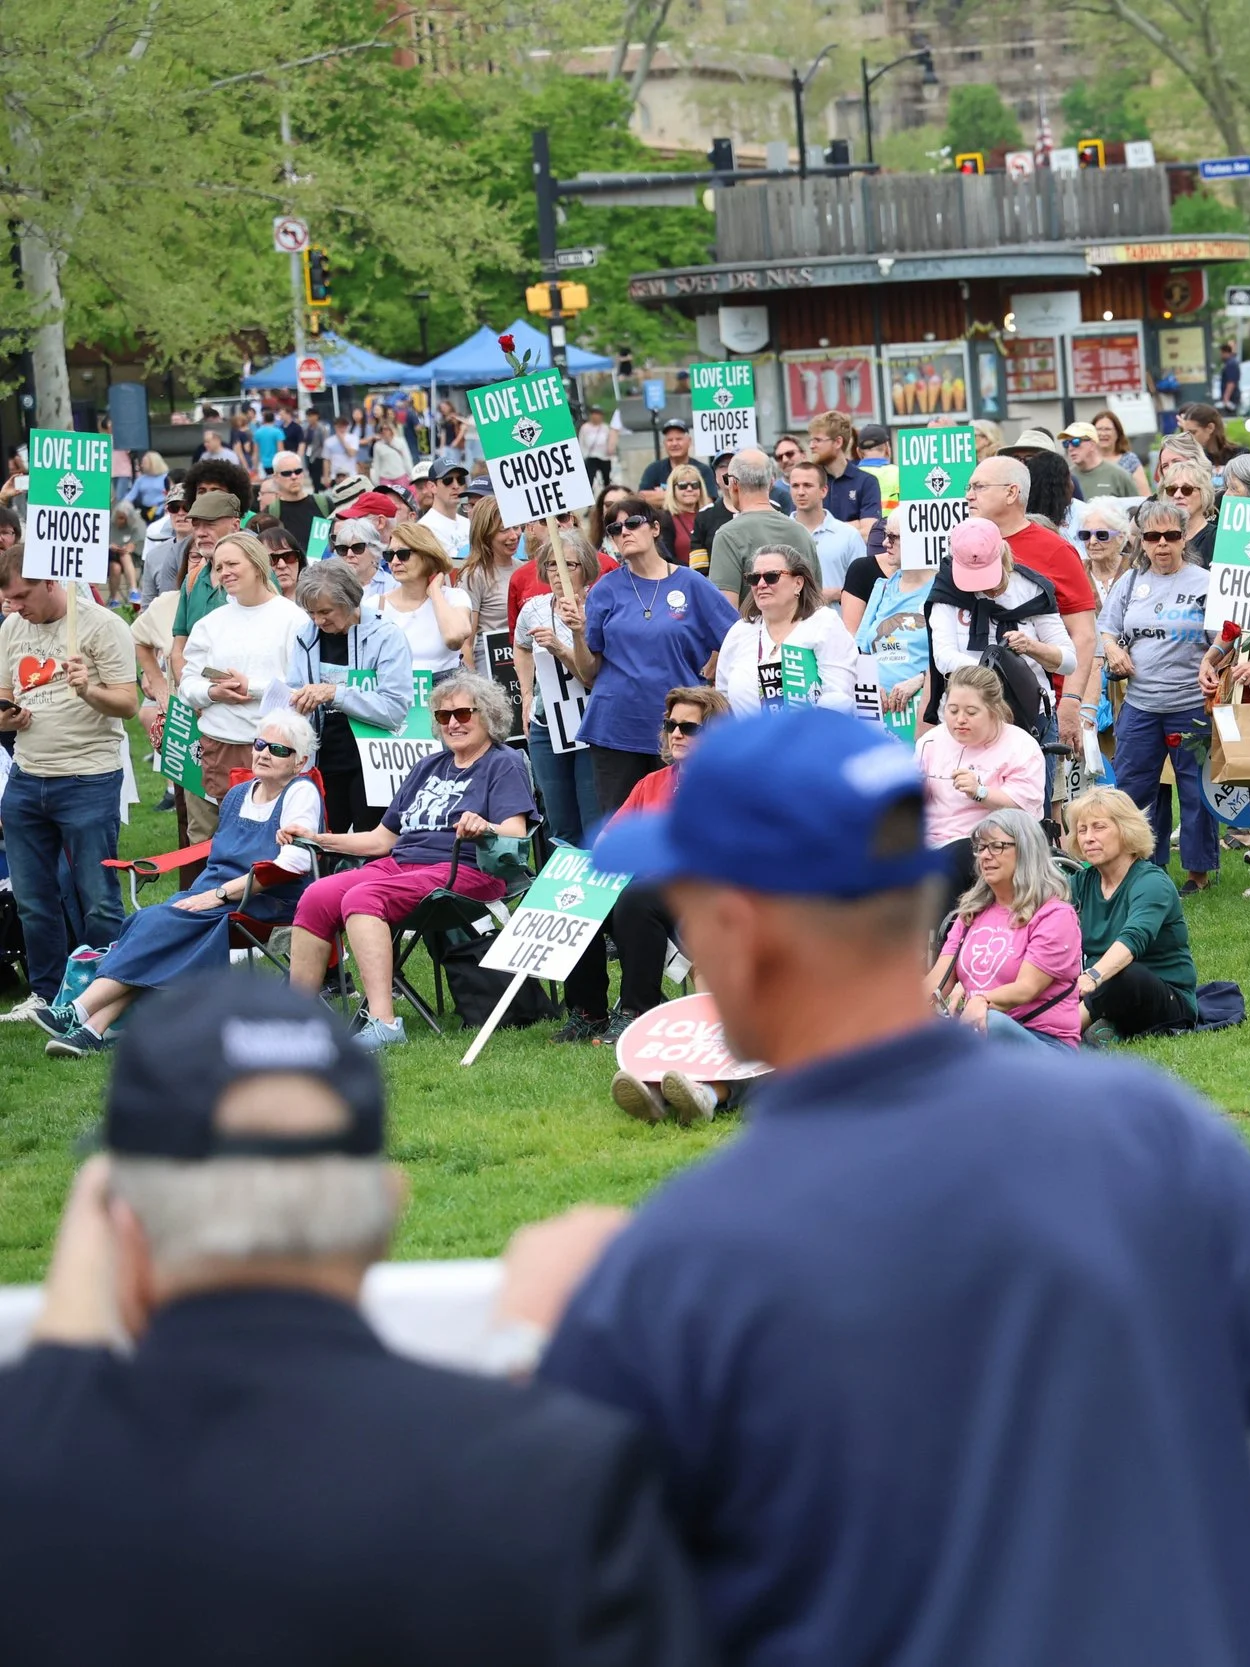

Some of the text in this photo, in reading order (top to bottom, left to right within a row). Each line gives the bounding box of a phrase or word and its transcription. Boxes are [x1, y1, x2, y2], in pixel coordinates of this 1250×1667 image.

[728, 267, 814, 289] DRNKS
[692, 365, 750, 388] LOVE LIFE
[474, 376, 563, 425] LOVE LIFE
[700, 410, 749, 431] CHOOSE
[34, 436, 108, 472] LOVE LIFE
[901, 432, 973, 466] LOVE LIFE
[500, 444, 575, 489] CHOOSE
[525, 481, 566, 517] LIFE
[36, 509, 100, 544] CHOOSE
[313, 520, 331, 540] LO
[51, 546, 83, 578] LIFE
[924, 536, 947, 565] LIF
[881, 642, 902, 651] SAVE
[1132, 628, 1166, 640] FOR
[494, 646, 514, 661] PR
[784, 649, 807, 687] LIFE
[855, 683, 880, 721] LIFE
[164, 701, 193, 782] LOVE LIFE
[543, 853, 593, 882] LOVE
[512, 911, 590, 948] CHOOSE
[508, 941, 554, 972] LIFE
[645, 1018, 727, 1042] LOV
[634, 1041, 730, 1066] BOTH
